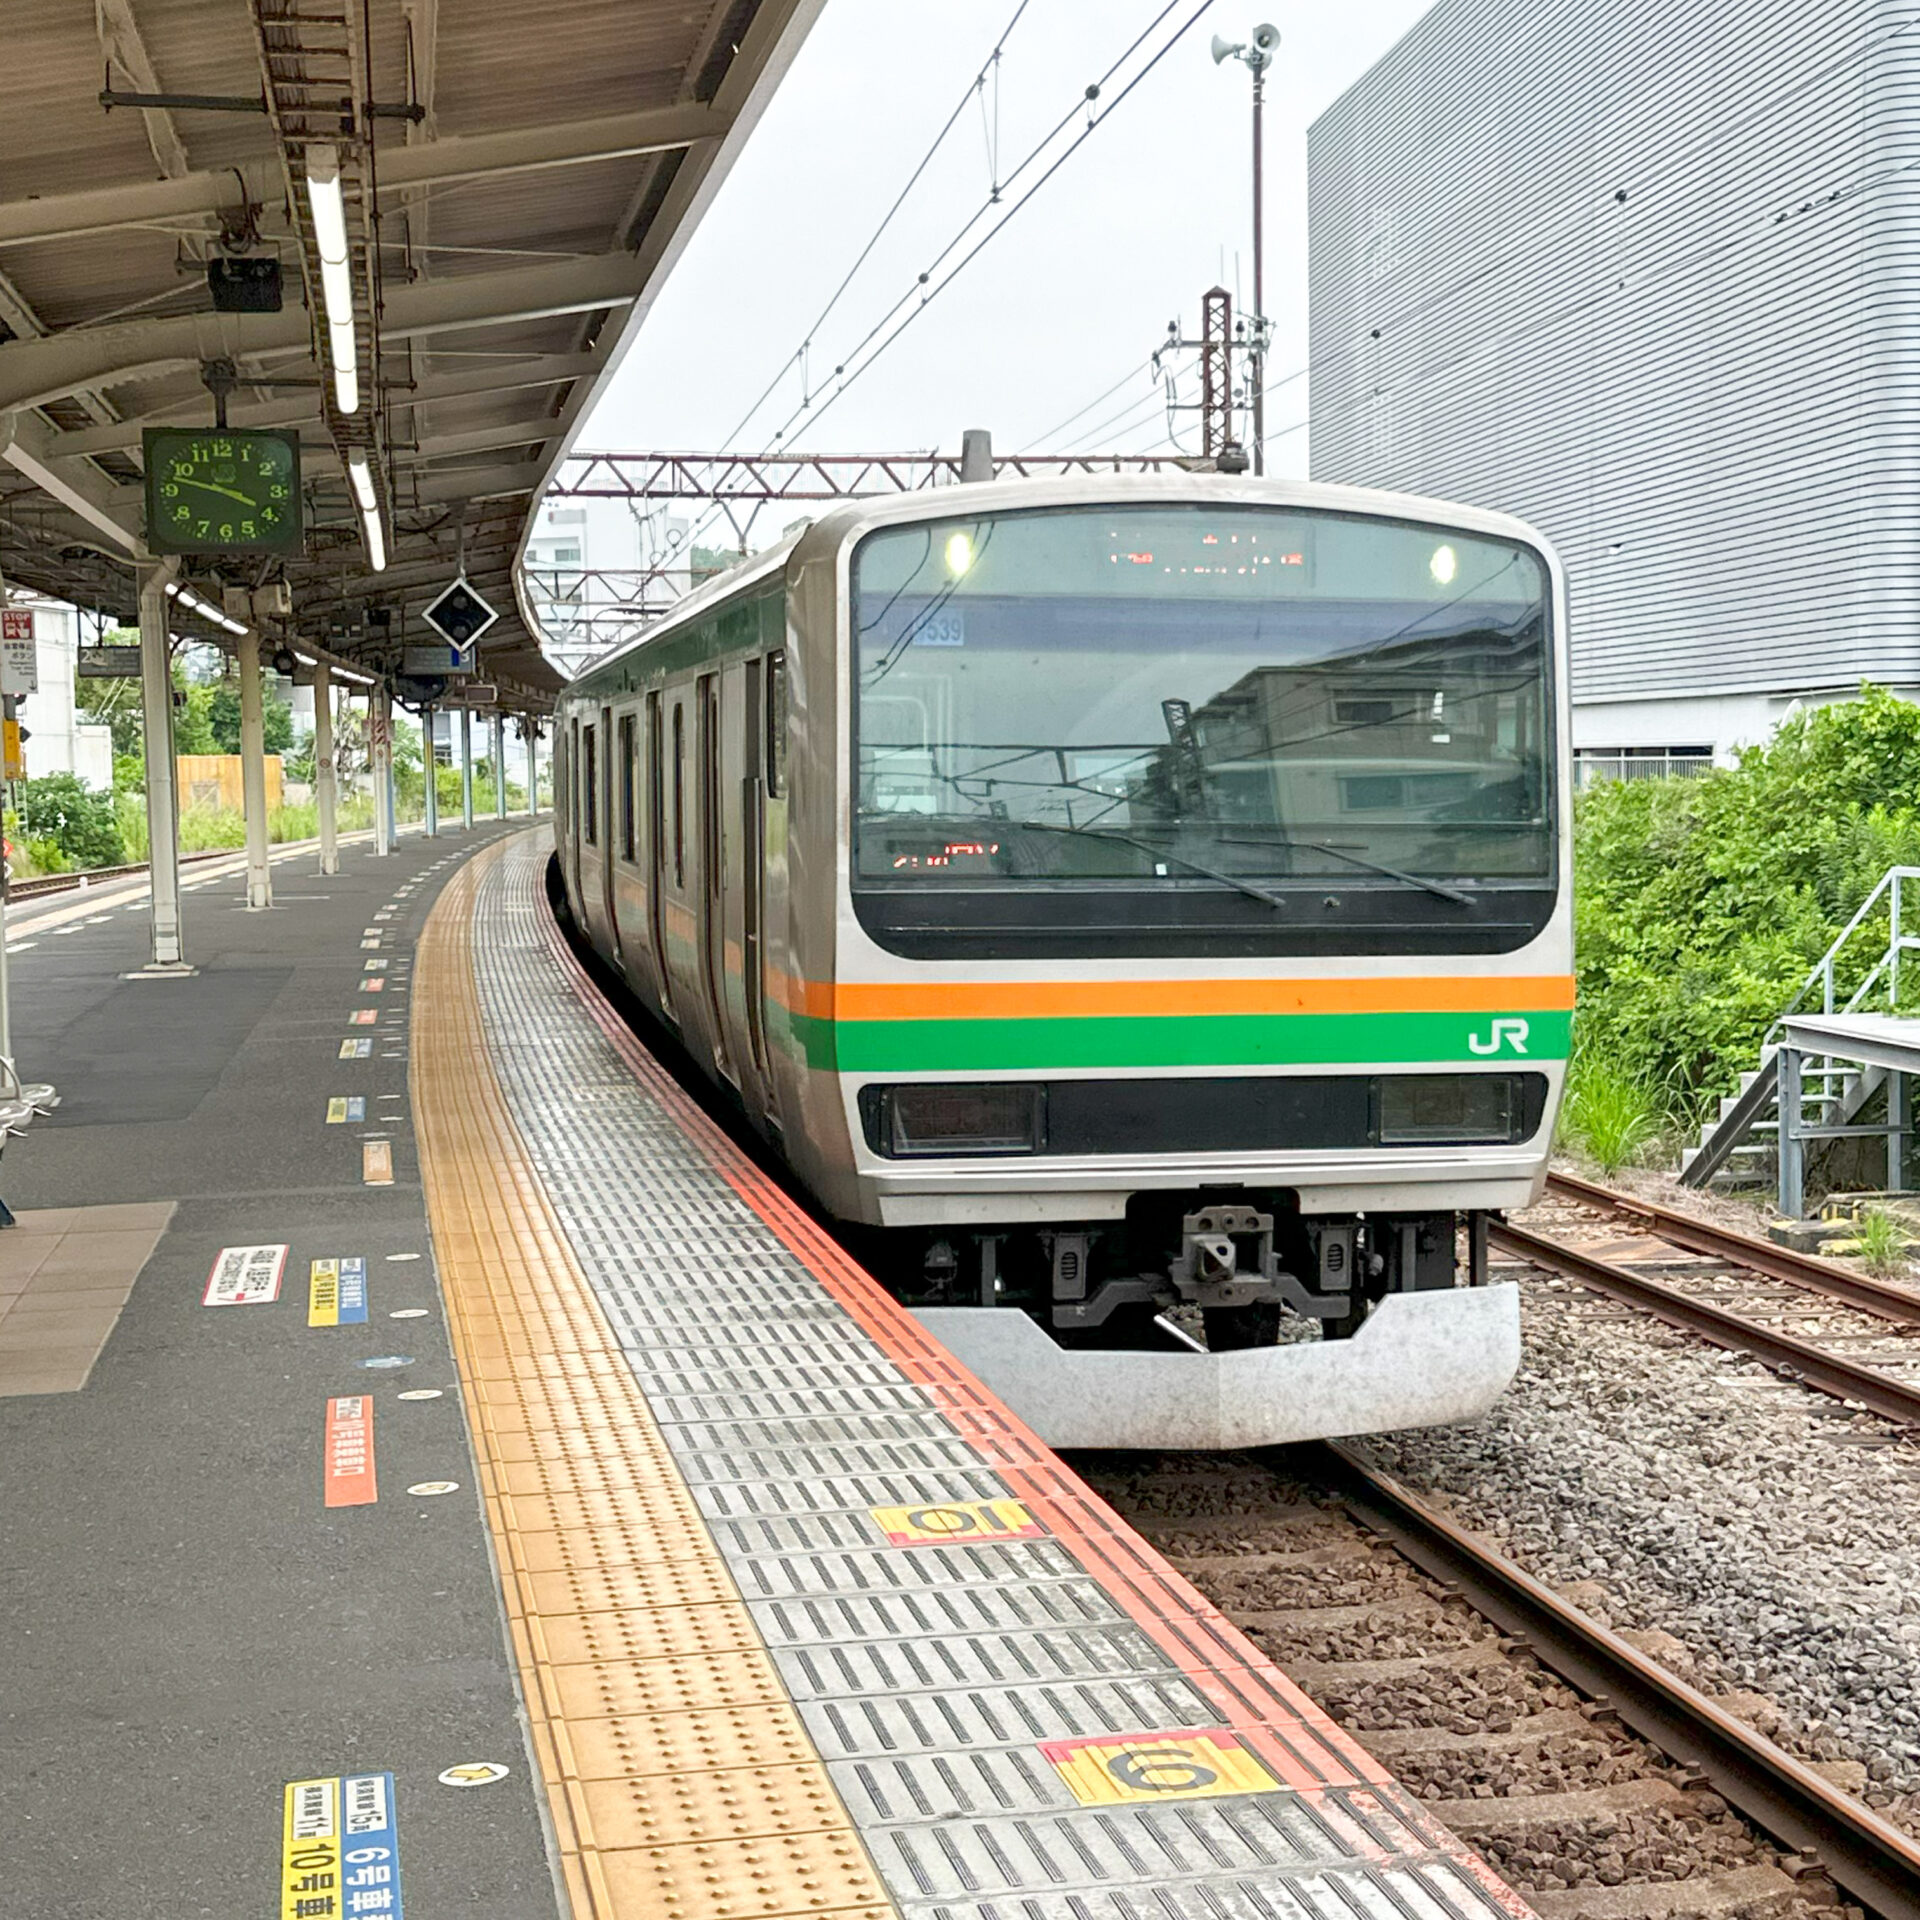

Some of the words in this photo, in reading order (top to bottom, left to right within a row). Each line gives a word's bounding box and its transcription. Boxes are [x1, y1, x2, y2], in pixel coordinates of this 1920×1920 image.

[192, 450, 209, 462] 11
[212, 443, 232, 457] 12
[241, 450, 249, 461] 1
[174, 463, 194, 476] 10
[259, 462, 273, 476] 2
[165, 483, 179, 497] 9
[270, 484, 283, 498] 3
[177, 506, 191, 519] 8
[261, 507, 274, 521] 4
[198, 520, 210, 534] 7
[219, 524, 233, 538] 6
[241, 520, 255, 534] 5
[1468, 1018, 1529, 1055] JR
[907, 1505, 1008, 1534] 10
[1107, 1748, 1217, 1792] 6
